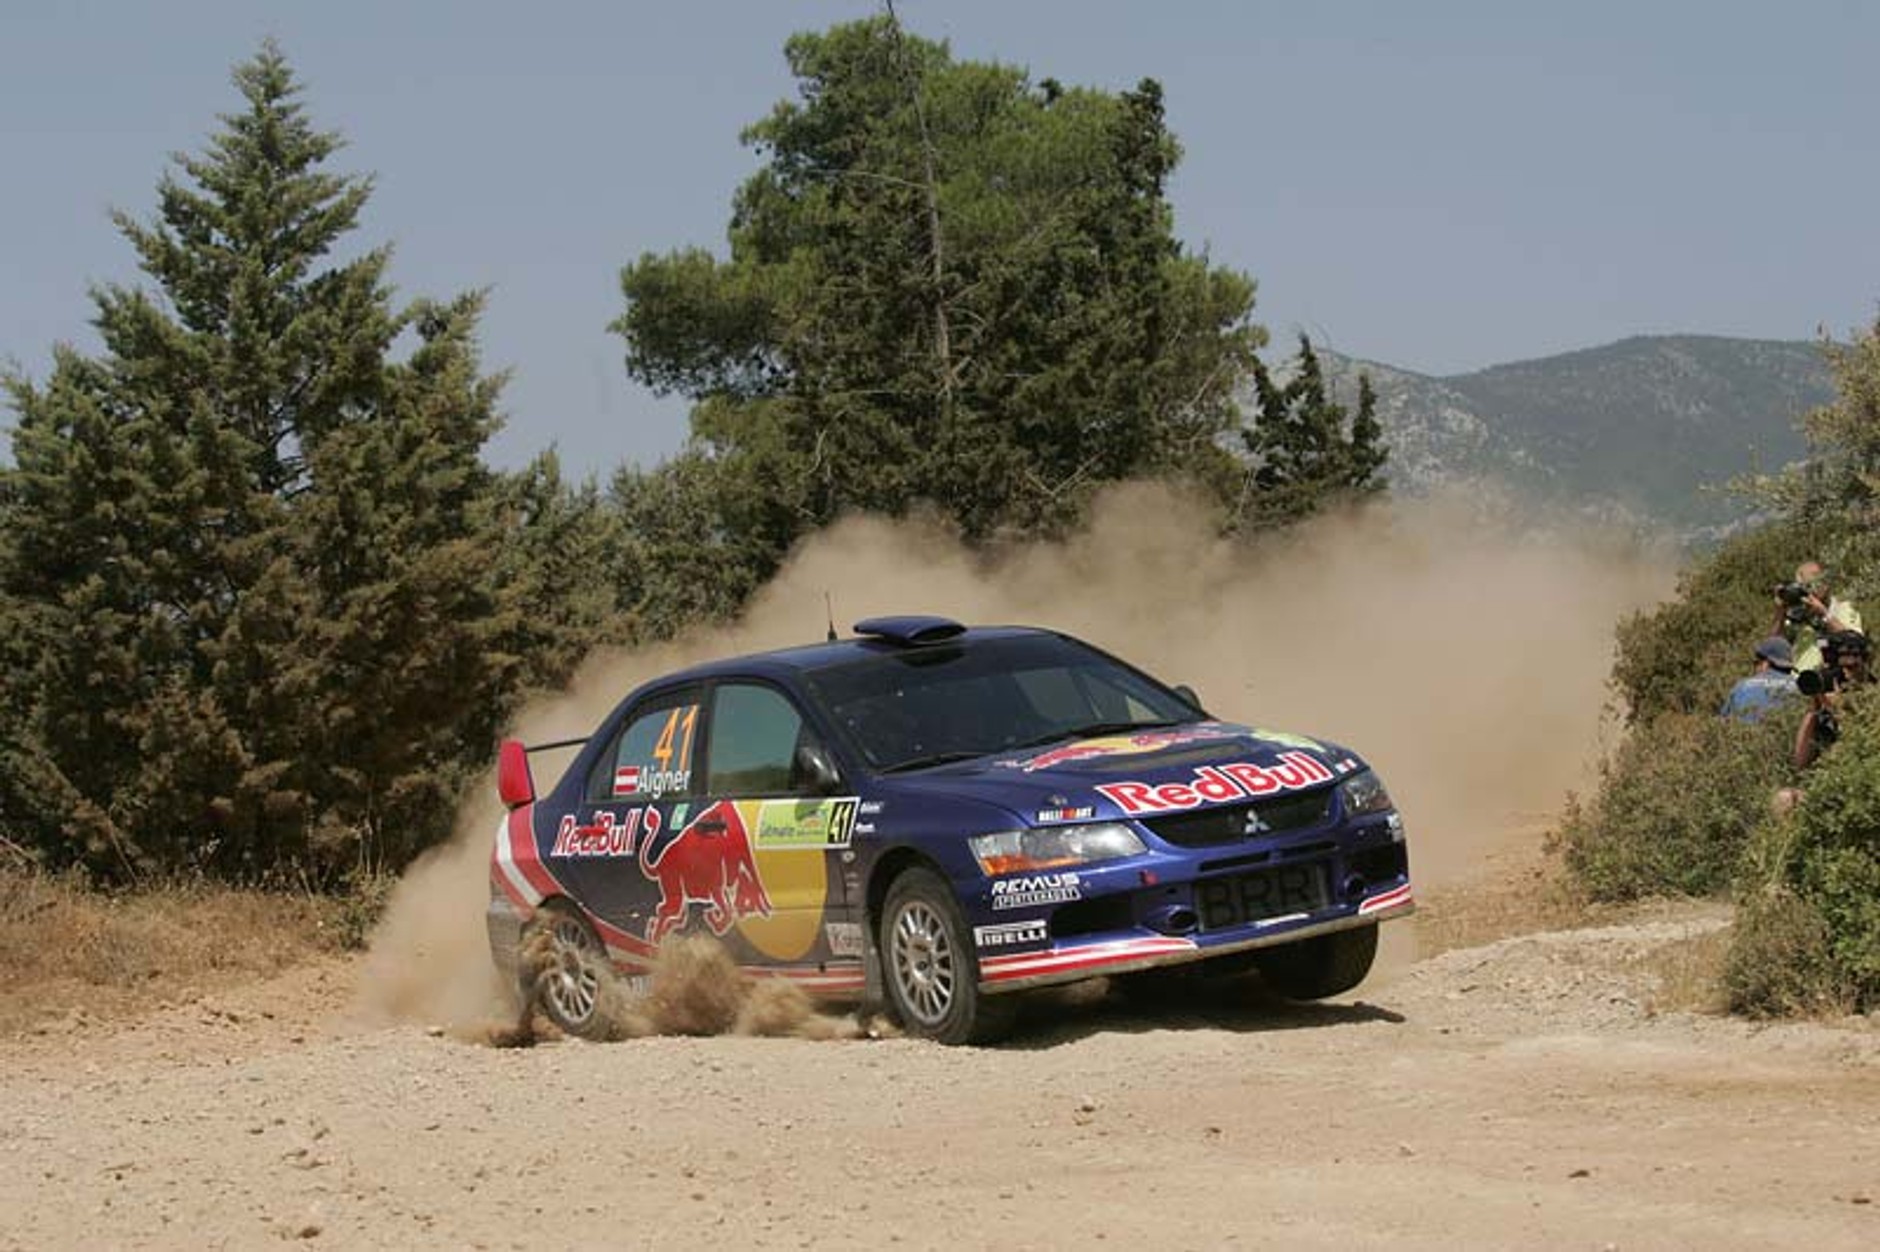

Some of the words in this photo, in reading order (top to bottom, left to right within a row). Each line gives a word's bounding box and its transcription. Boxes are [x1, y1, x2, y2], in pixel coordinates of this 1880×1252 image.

[652, 705, 698, 772] 41
[639, 765, 692, 799] Aigner
[1094, 765, 1247, 814] Red
[1215, 750, 1335, 796] Bull
[829, 802, 853, 843] 41
[991, 873, 1081, 897] REMUS
[973, 919, 1047, 947] PIRELLI
